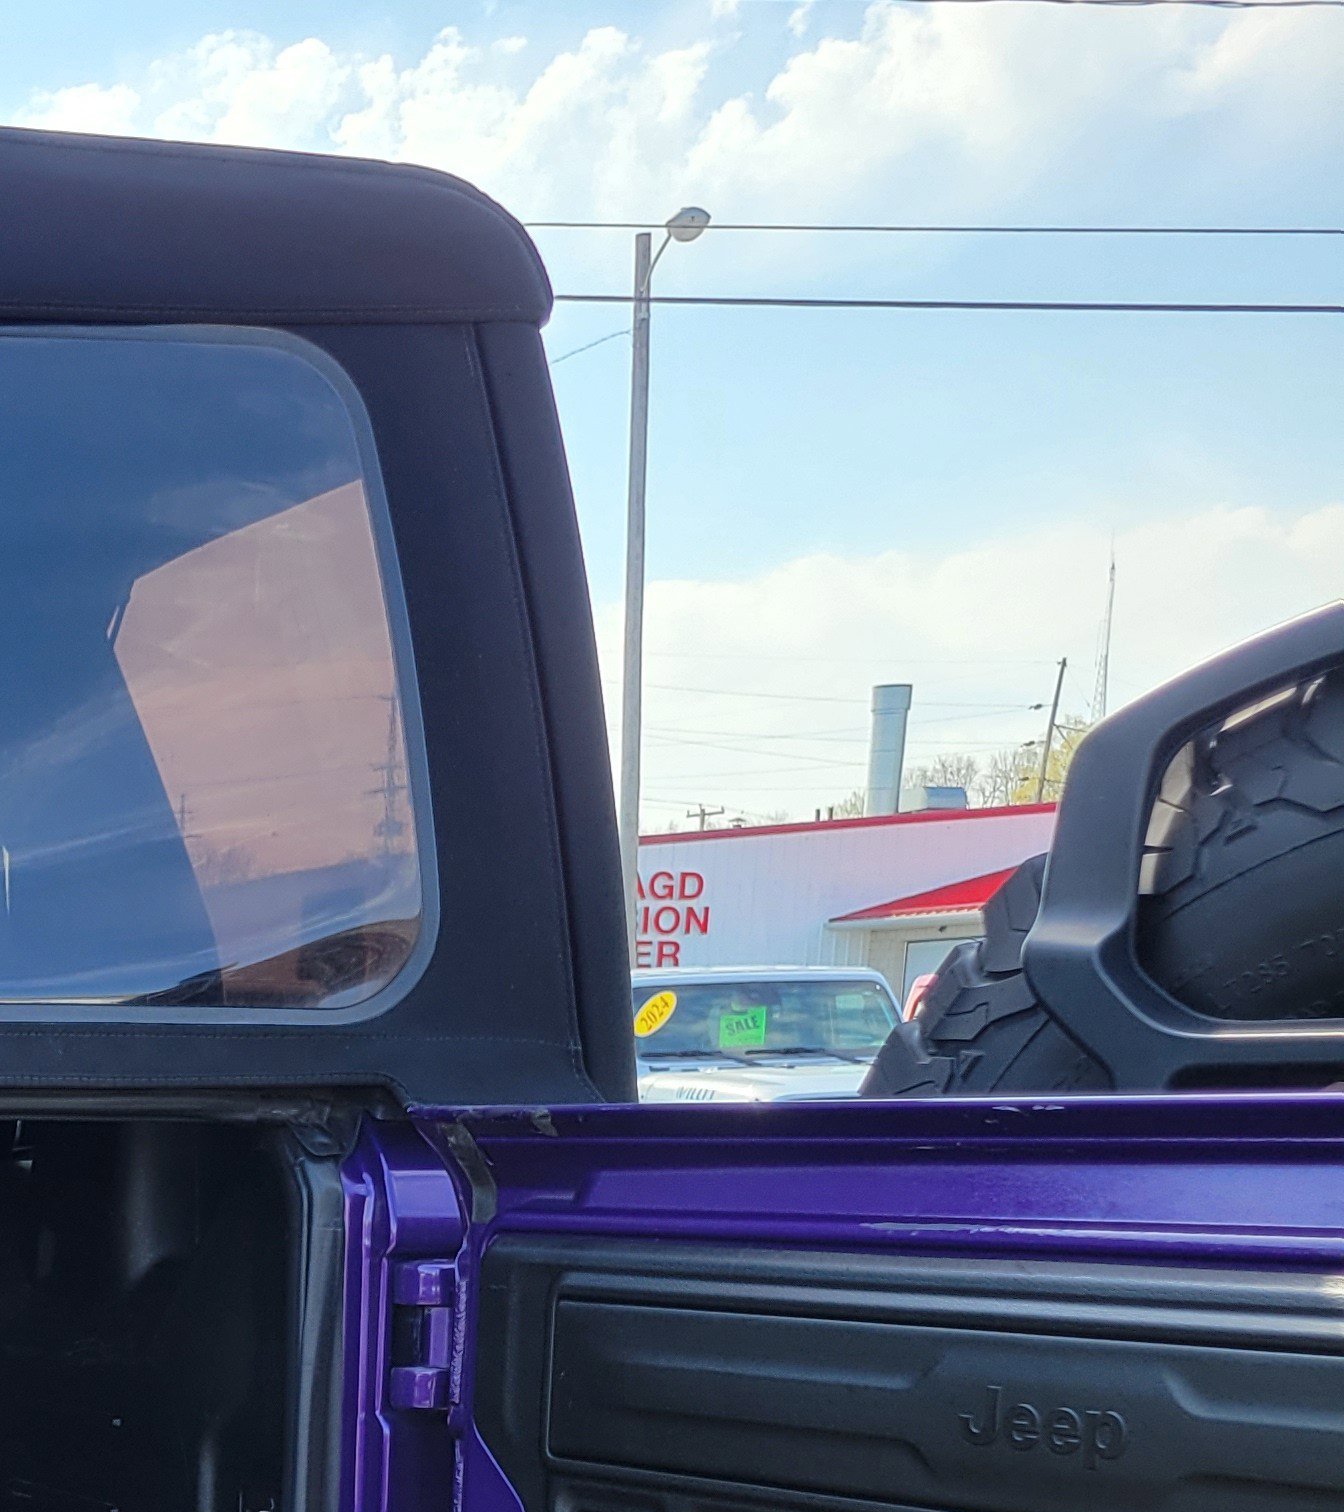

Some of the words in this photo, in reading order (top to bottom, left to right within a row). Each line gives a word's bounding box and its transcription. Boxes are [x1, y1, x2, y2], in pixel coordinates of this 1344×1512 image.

[640, 996, 670, 1031] 2024
[726, 1015, 760, 1036] SALE
[958, 1385, 1128, 1471] Jeep
